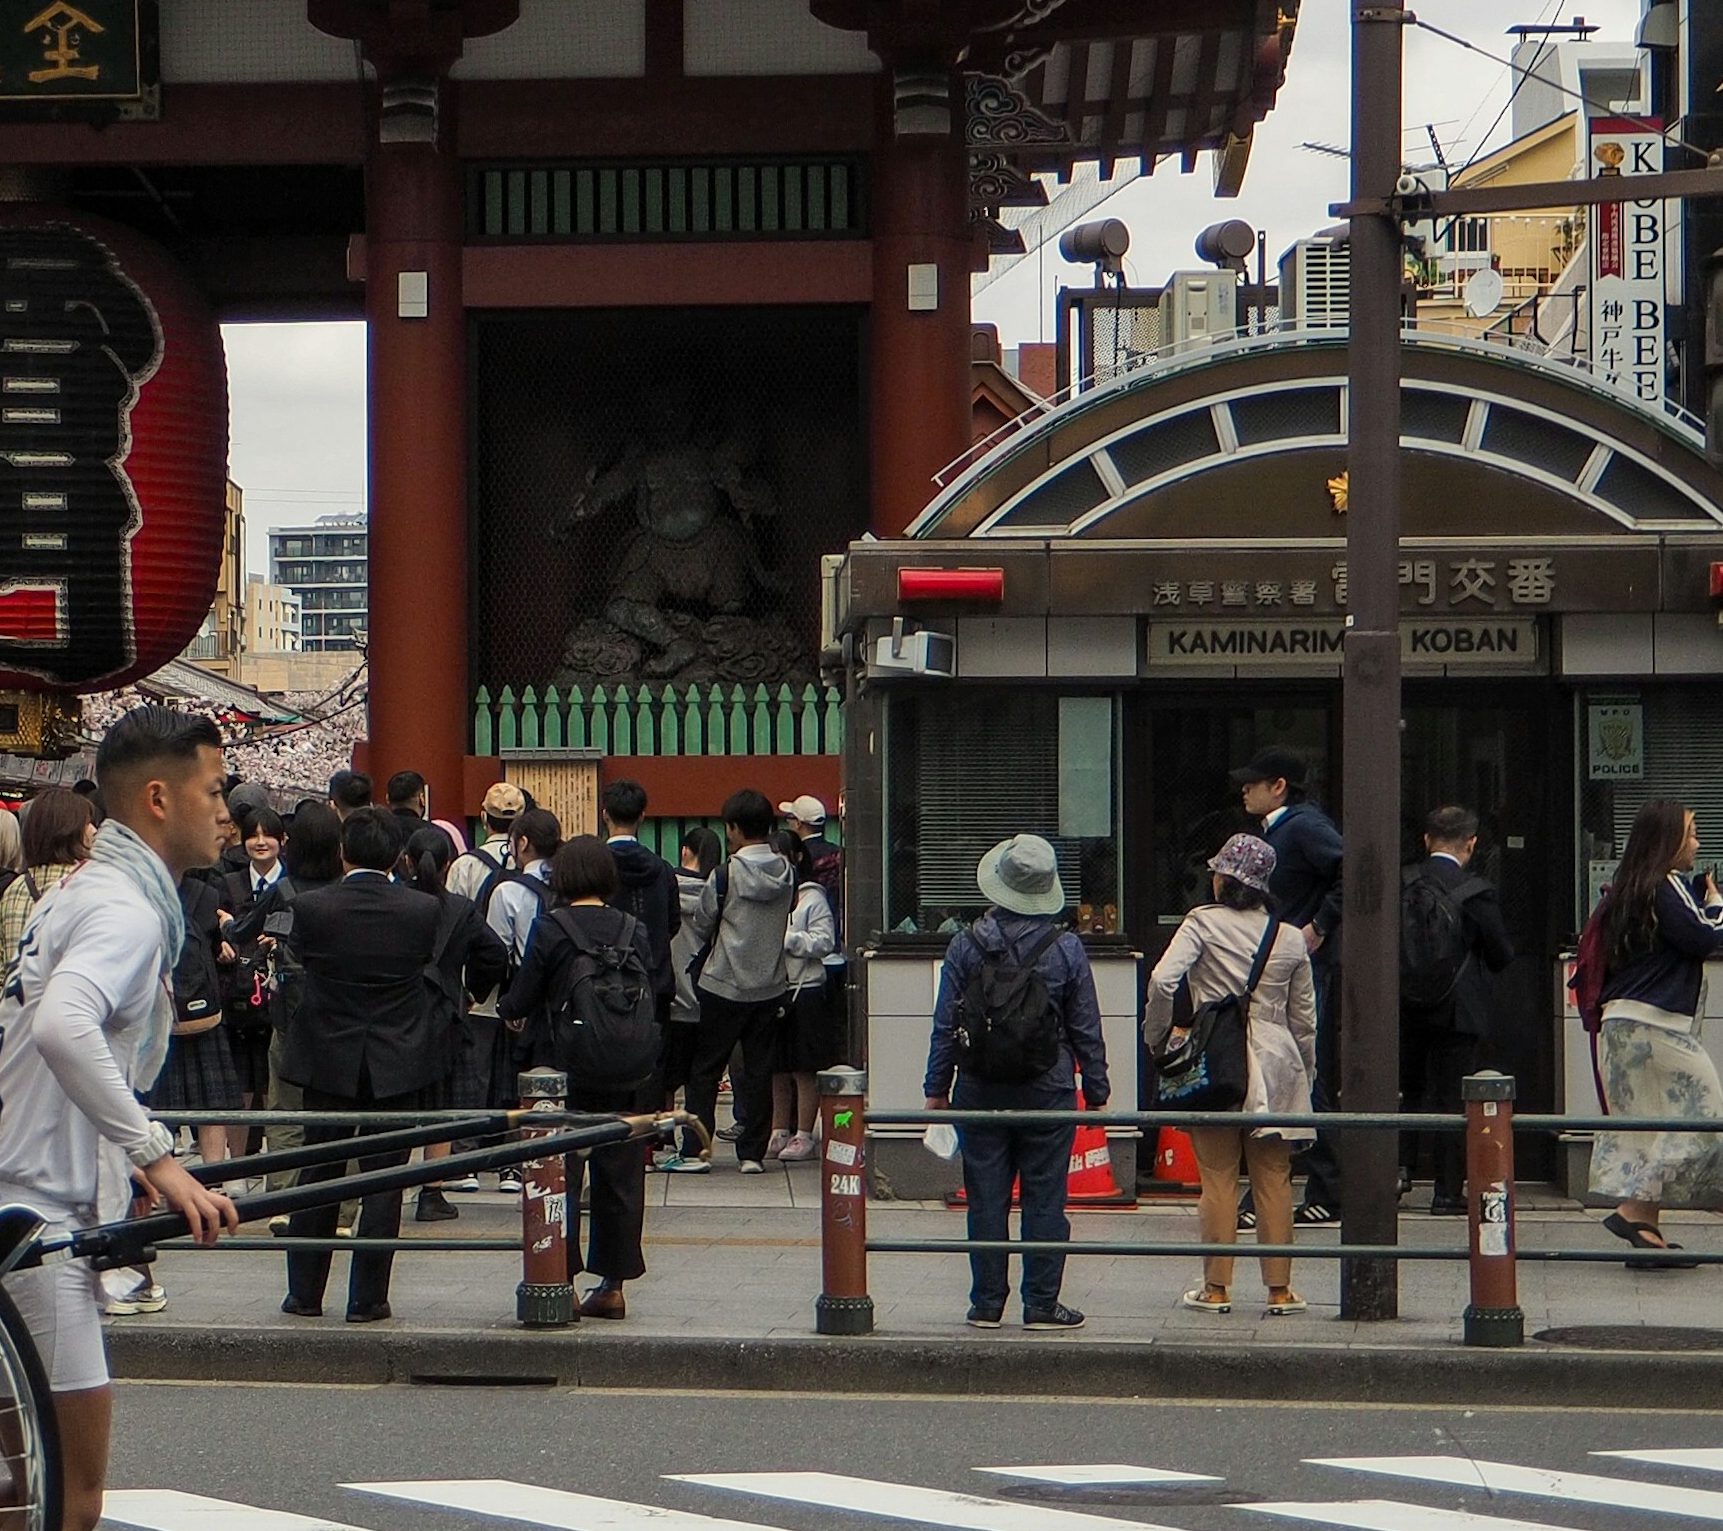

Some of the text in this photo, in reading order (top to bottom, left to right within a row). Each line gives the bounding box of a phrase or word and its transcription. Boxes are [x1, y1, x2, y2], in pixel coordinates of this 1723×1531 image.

[1600, 299, 1624, 385] 神戸牛
[1632, 299, 1660, 401] BEE
[1152, 579, 1319, 607] 浅草警察署
[1168, 628, 1518, 655] KAMINARIM KOBAN
[1592, 764, 1640, 774] POLICE
[830, 1174, 861, 1195] 24K
